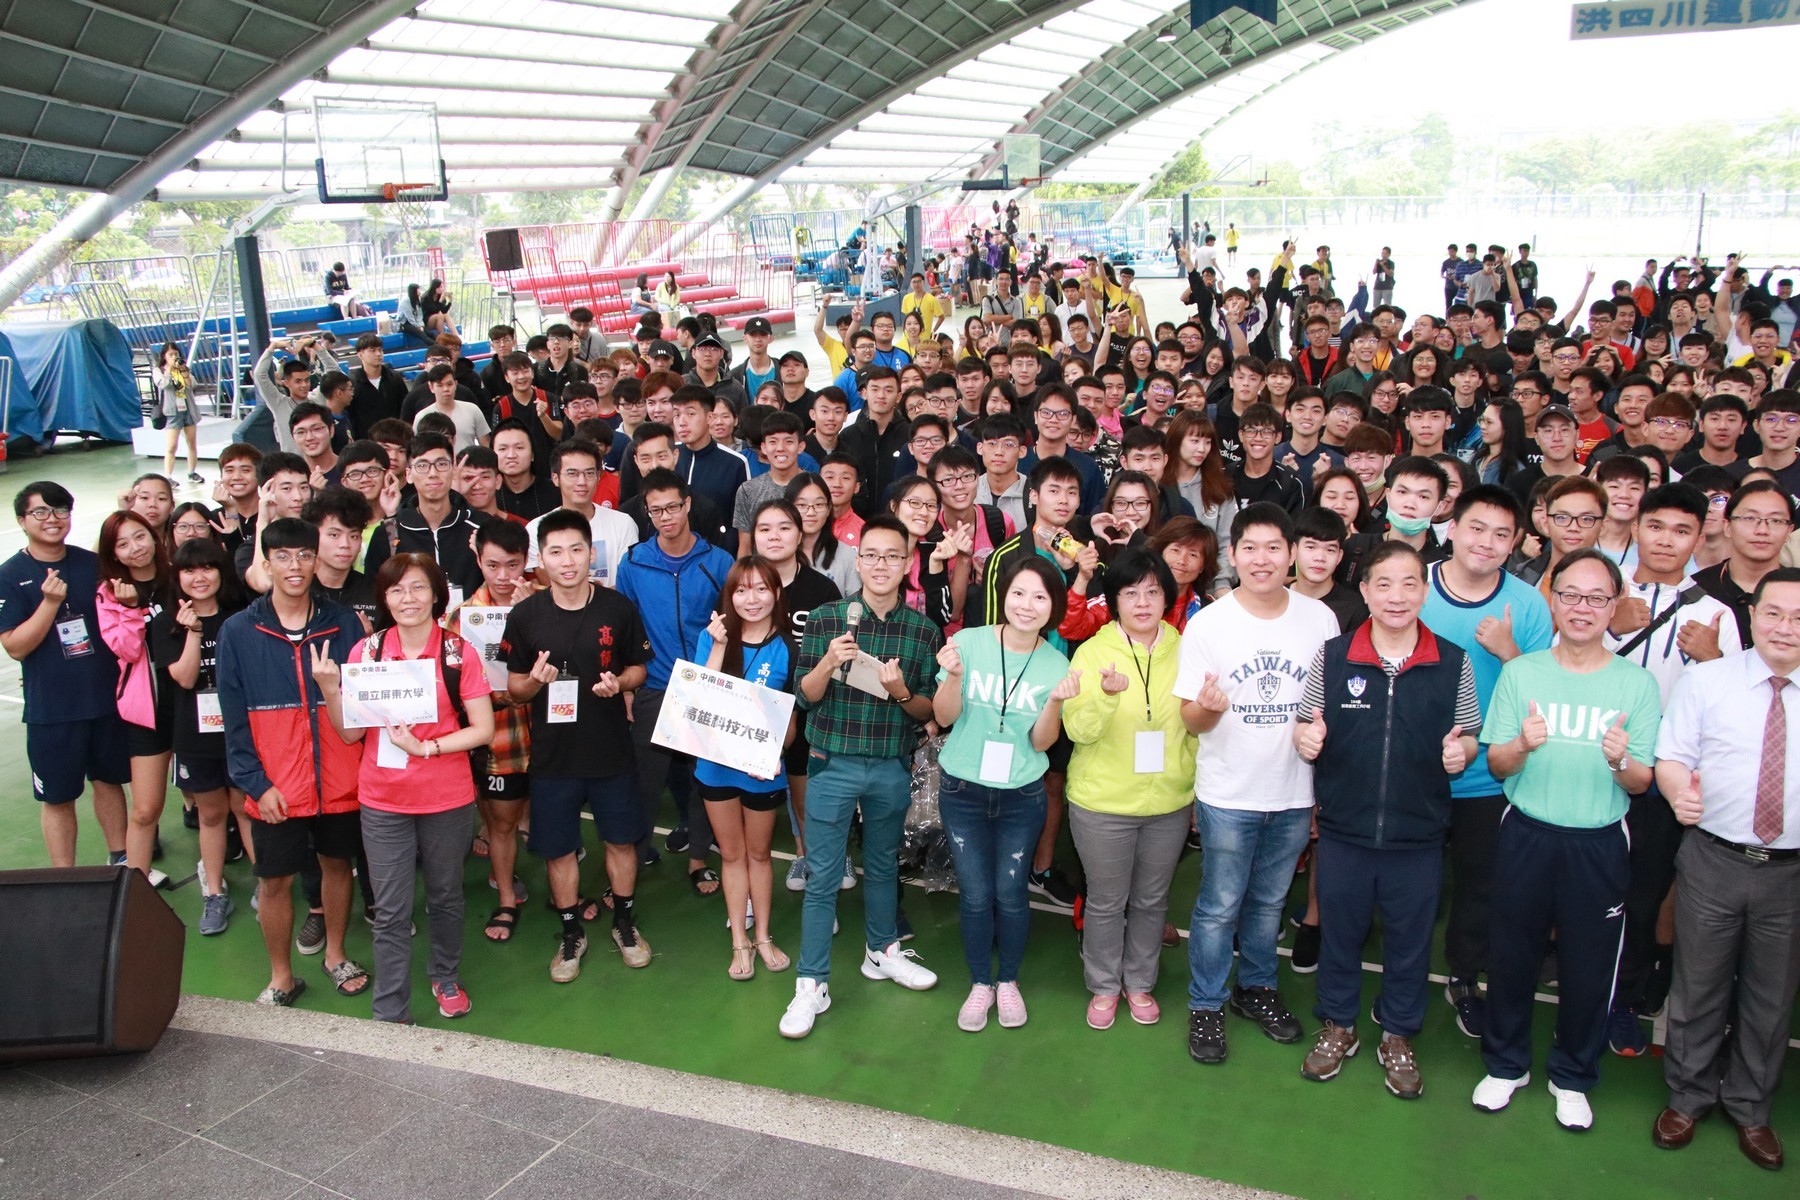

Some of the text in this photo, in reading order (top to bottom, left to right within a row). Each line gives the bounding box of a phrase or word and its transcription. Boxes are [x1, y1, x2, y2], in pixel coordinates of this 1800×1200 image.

[1576, 0, 1800, 33] 洪四川運動
[1229, 656, 1308, 684] TAIWAN
[358, 687, 424, 702] 國立屏東大學
[968, 669, 1046, 712] NUK
[1232, 702, 1301, 714] UNIVERSITY
[1246, 715, 1285, 724] OF SPORT
[1535, 702, 1620, 741] NUK
[683, 705, 770, 743] 高雄科技大學
[488, 775, 505, 792] 20
